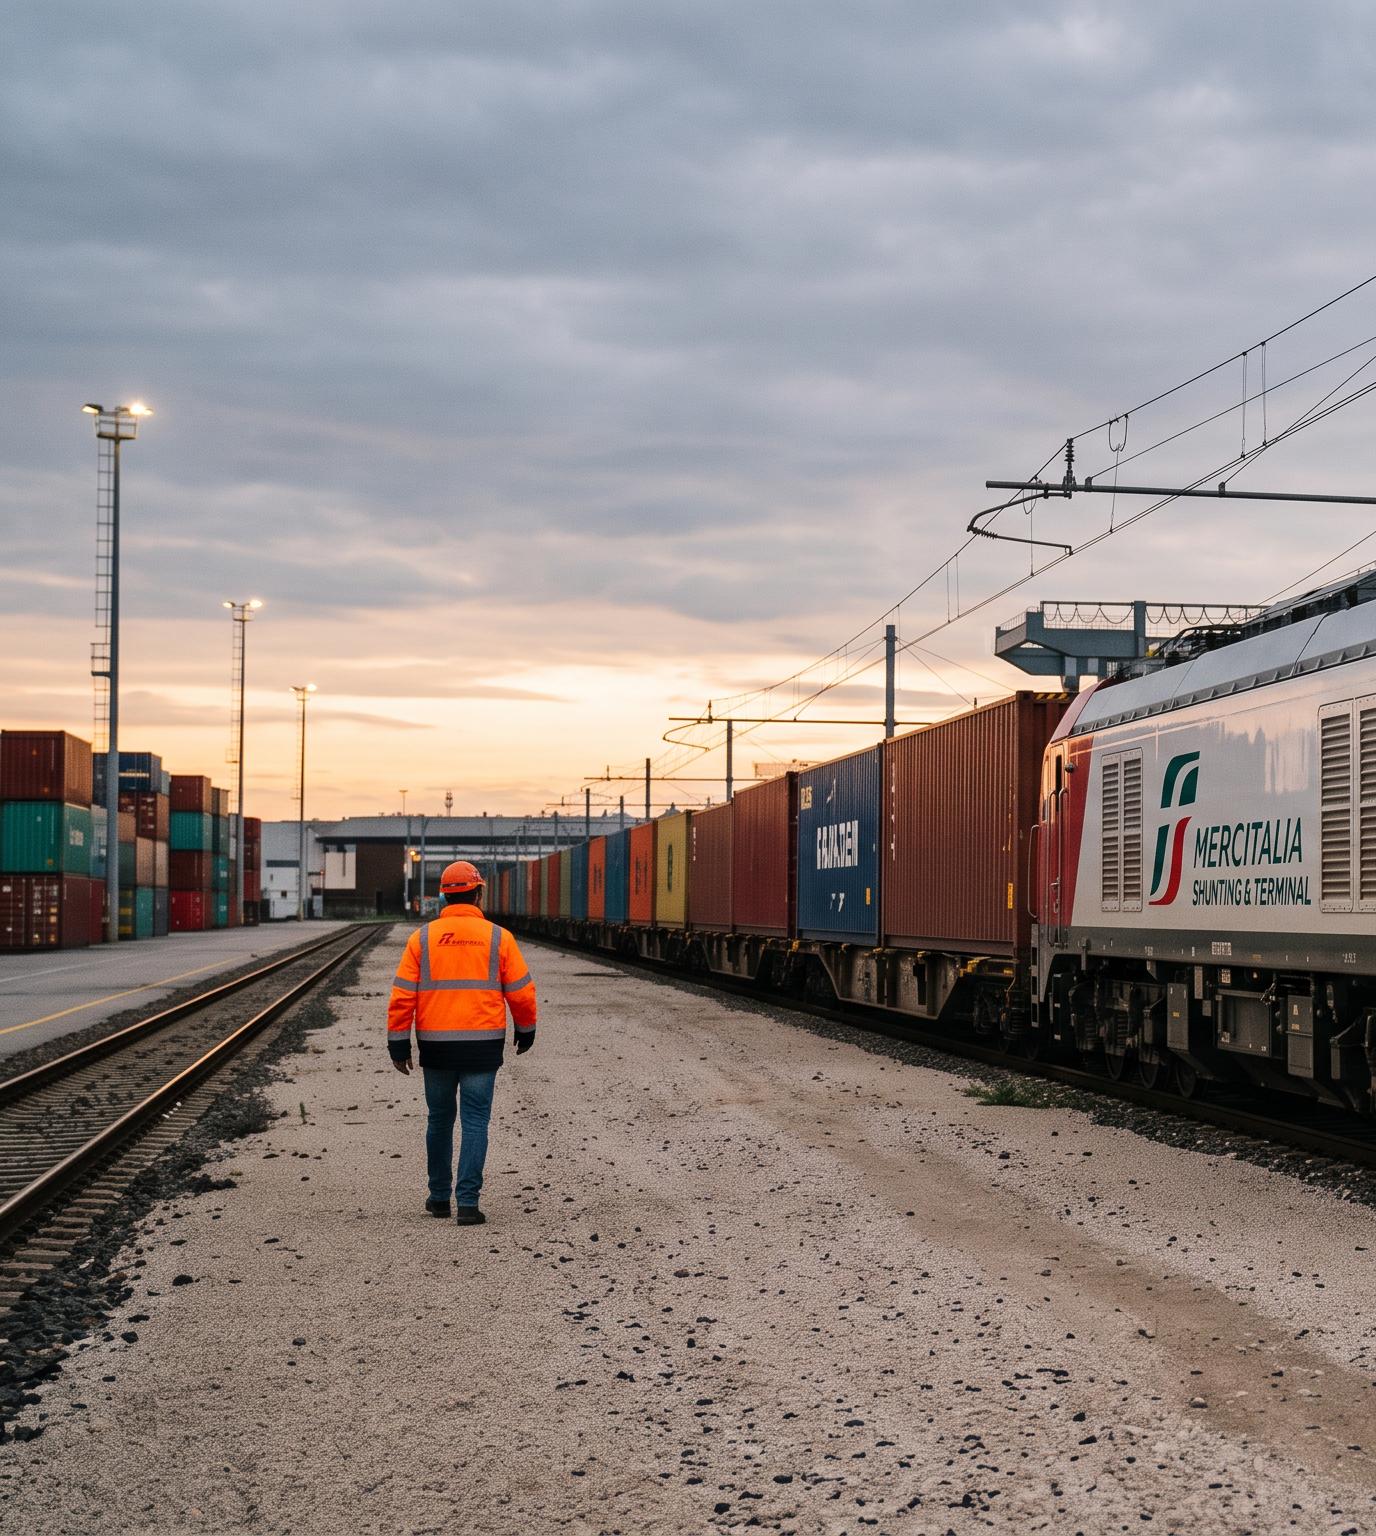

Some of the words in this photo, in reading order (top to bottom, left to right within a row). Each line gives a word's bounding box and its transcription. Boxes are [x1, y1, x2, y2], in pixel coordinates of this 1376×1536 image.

[1194, 817, 1302, 868] MERCITALIA
[1192, 879, 1242, 906] SHUNTING
[1244, 879, 1252, 906] &
[1254, 876, 1311, 906] TERMINAL
